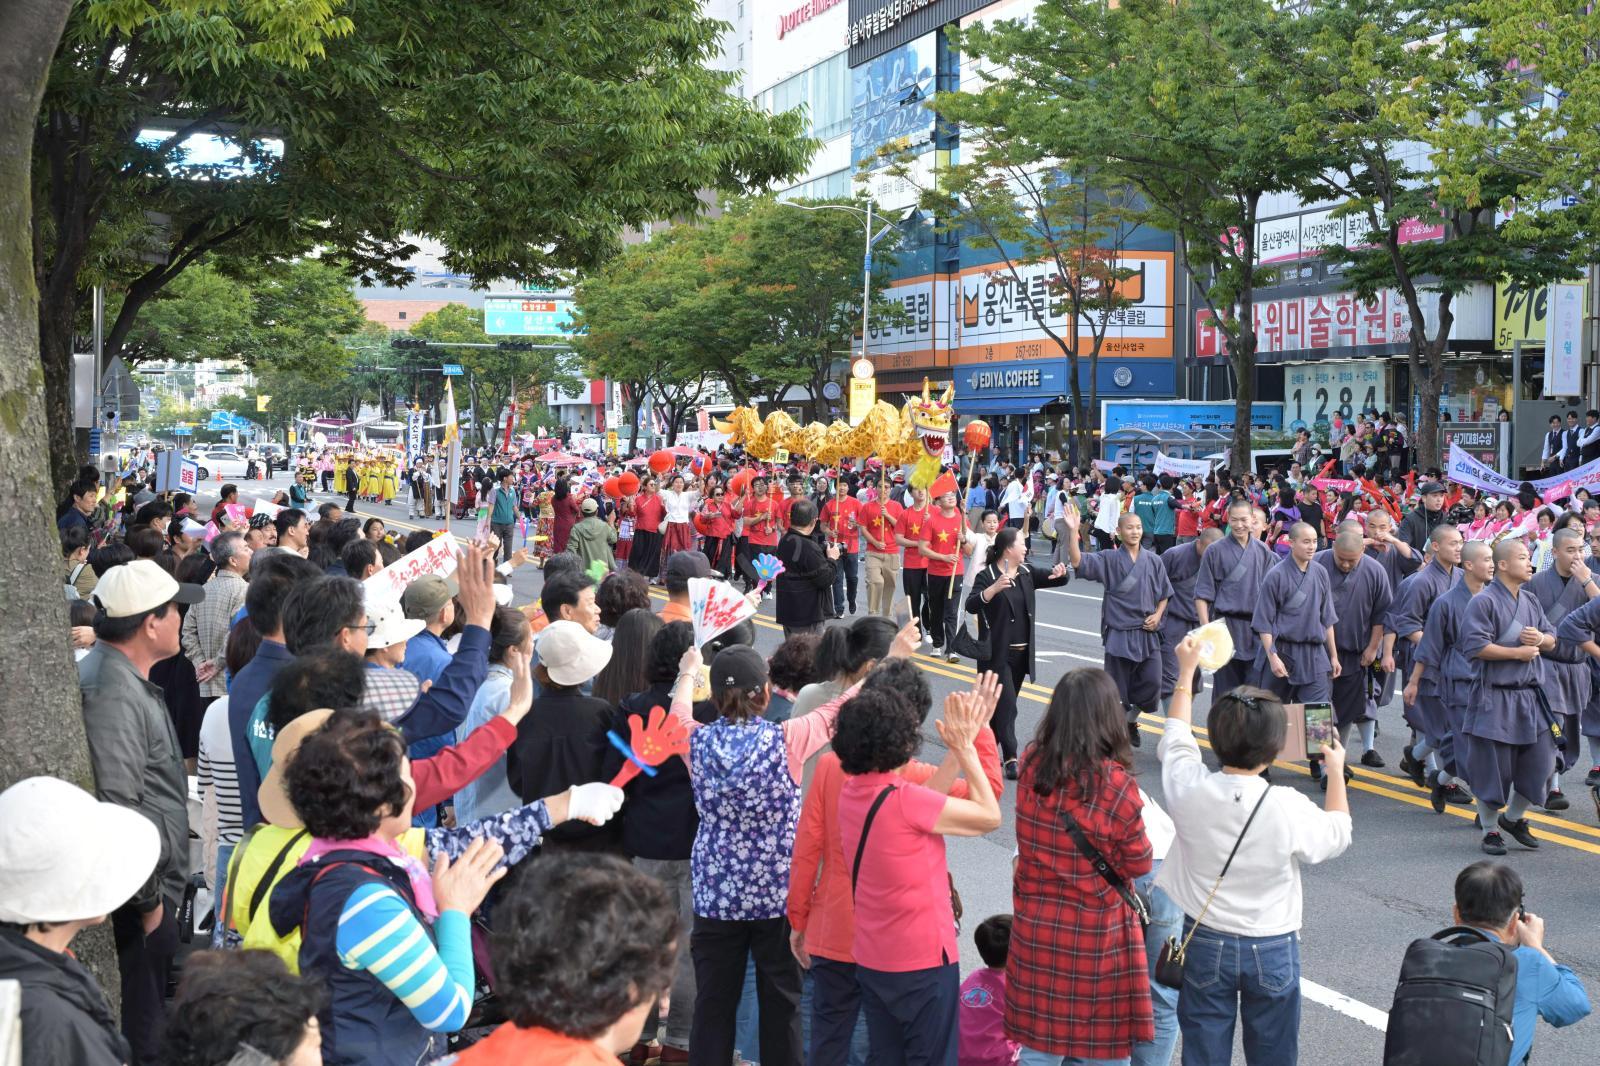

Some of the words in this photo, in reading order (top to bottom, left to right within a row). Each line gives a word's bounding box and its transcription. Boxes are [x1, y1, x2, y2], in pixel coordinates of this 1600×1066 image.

[1262, 228, 1298, 251] 울산광역시
[1303, 221, 1342, 244] 시각장애인
[1222, 289, 1387, 355] 워미술학원
[1499, 328, 1513, 346] 5F
[1015, 344, 1042, 359] 267-0561
[1105, 343, 1121, 352] 울산
[1122, 343, 1145, 352] 사업국
[980, 370, 1004, 388] EDIYA
[1005, 369, 1041, 387] COFFEE
[1316, 387, 1329, 421] 2
[1339, 386, 1353, 420] 8
[1453, 432, 1493, 446] 실기대회수상
[1456, 460, 1480, 479] 선비의
